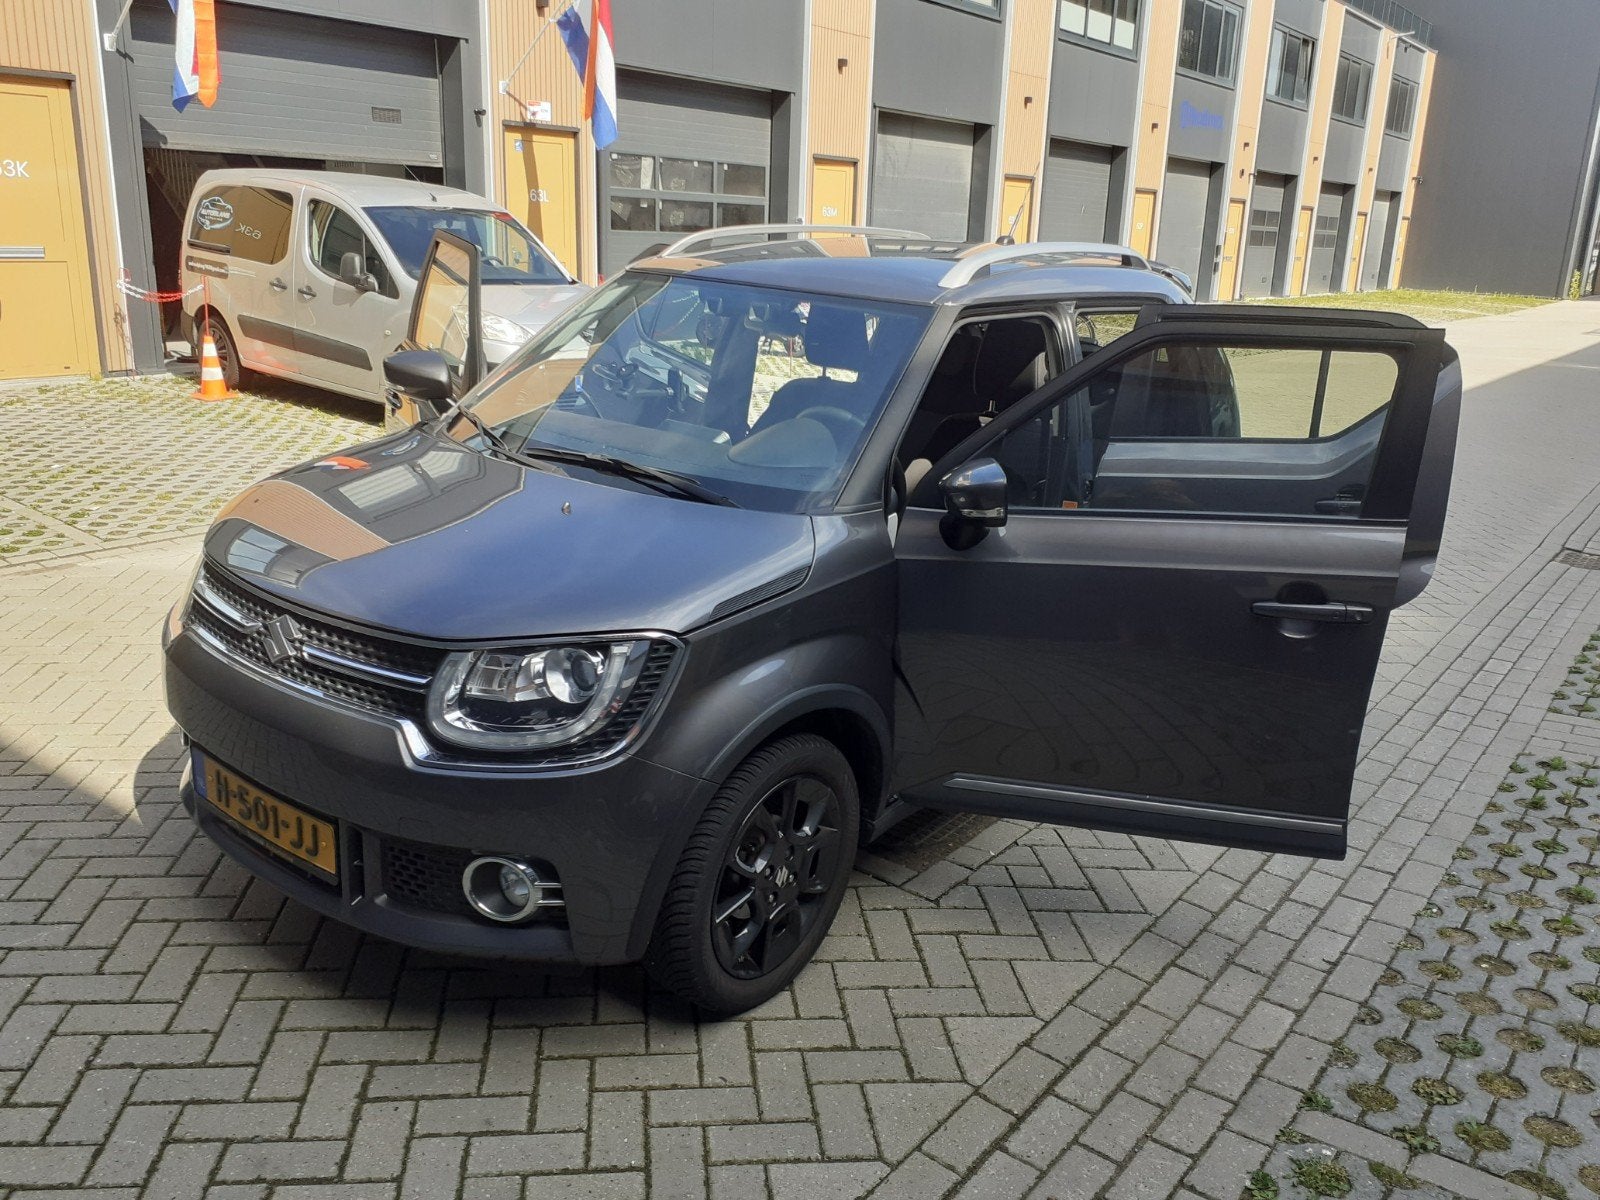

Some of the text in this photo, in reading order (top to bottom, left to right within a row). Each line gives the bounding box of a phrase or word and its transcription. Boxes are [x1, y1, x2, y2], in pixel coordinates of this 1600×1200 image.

[0, 159, 30, 178] 3K
[529, 188, 550, 203] 63L
[215, 769, 319, 857] H-501-JJ
